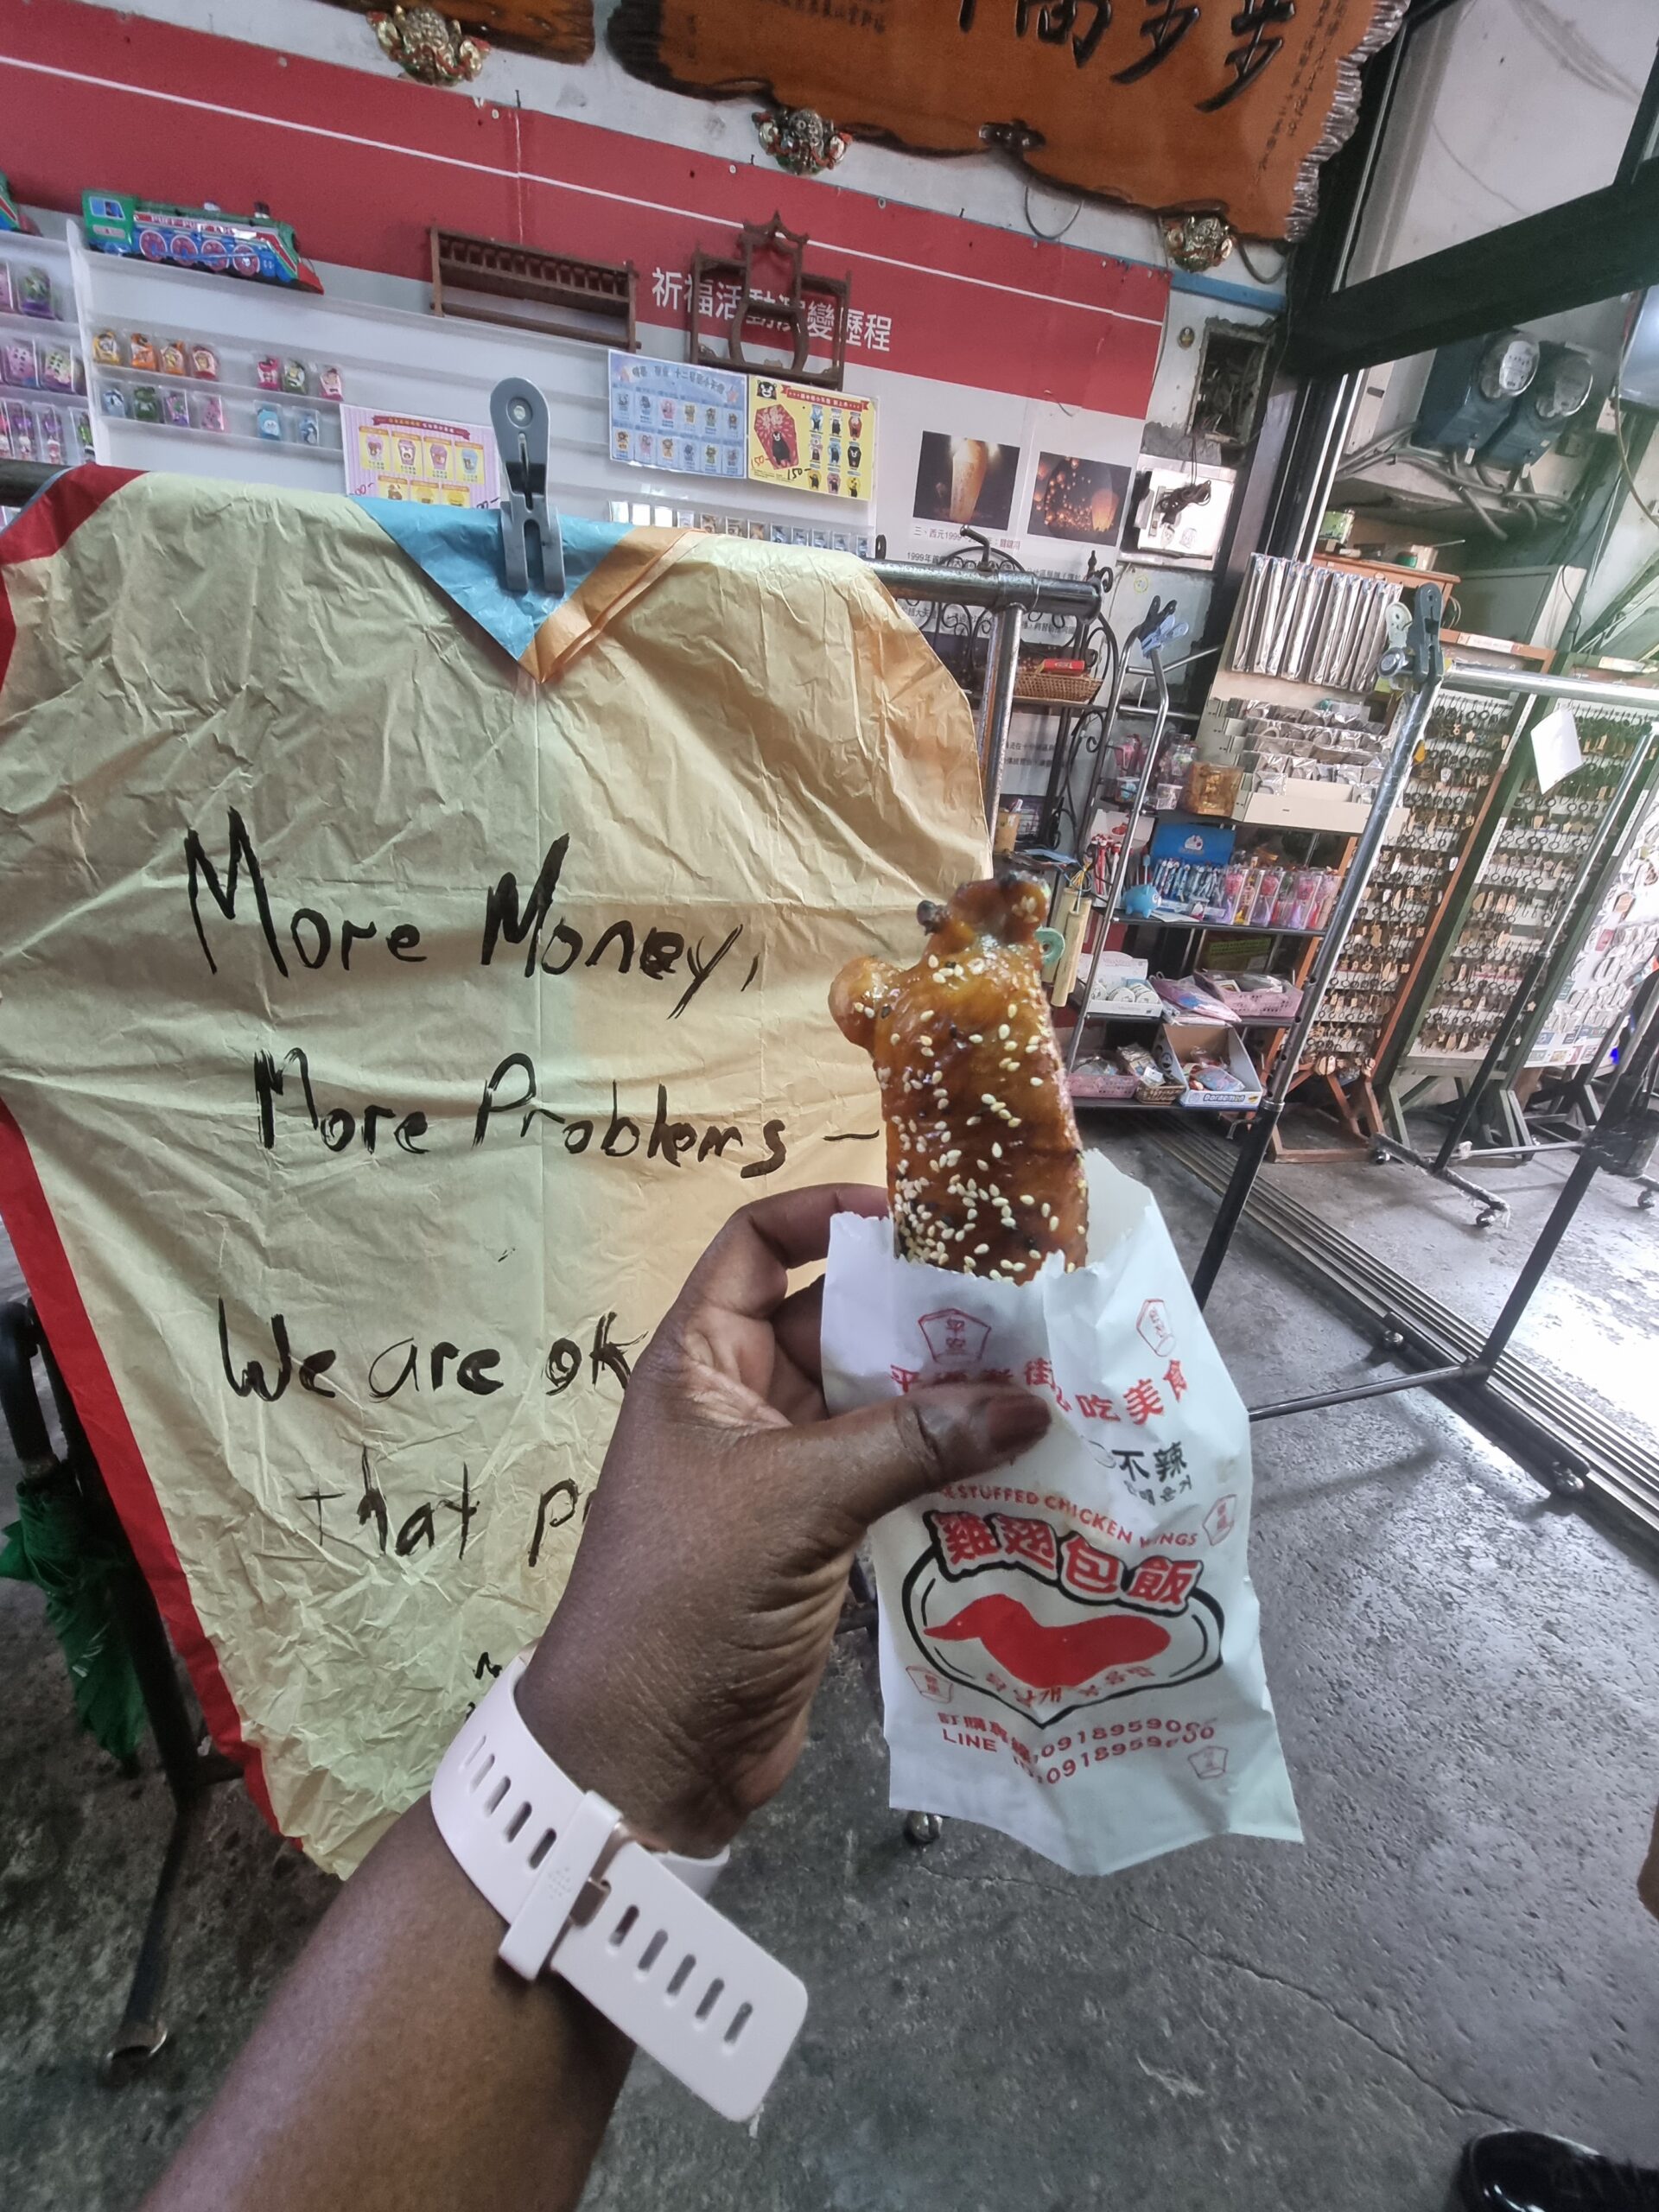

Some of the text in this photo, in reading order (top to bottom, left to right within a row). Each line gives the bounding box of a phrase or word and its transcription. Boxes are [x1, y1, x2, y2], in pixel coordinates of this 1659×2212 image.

[184, 804, 427, 978] More
[253, 1046, 429, 1154] More
[218, 1294, 338, 1402] We
[368, 1336, 505, 1403] are
[1111, 1440, 1188, 1482] 不辣
[957, 1484, 1041, 1506] STUFFED
[1045, 1495, 1133, 1546] CHICKEN
[942, 1729, 998, 1753] LINE
